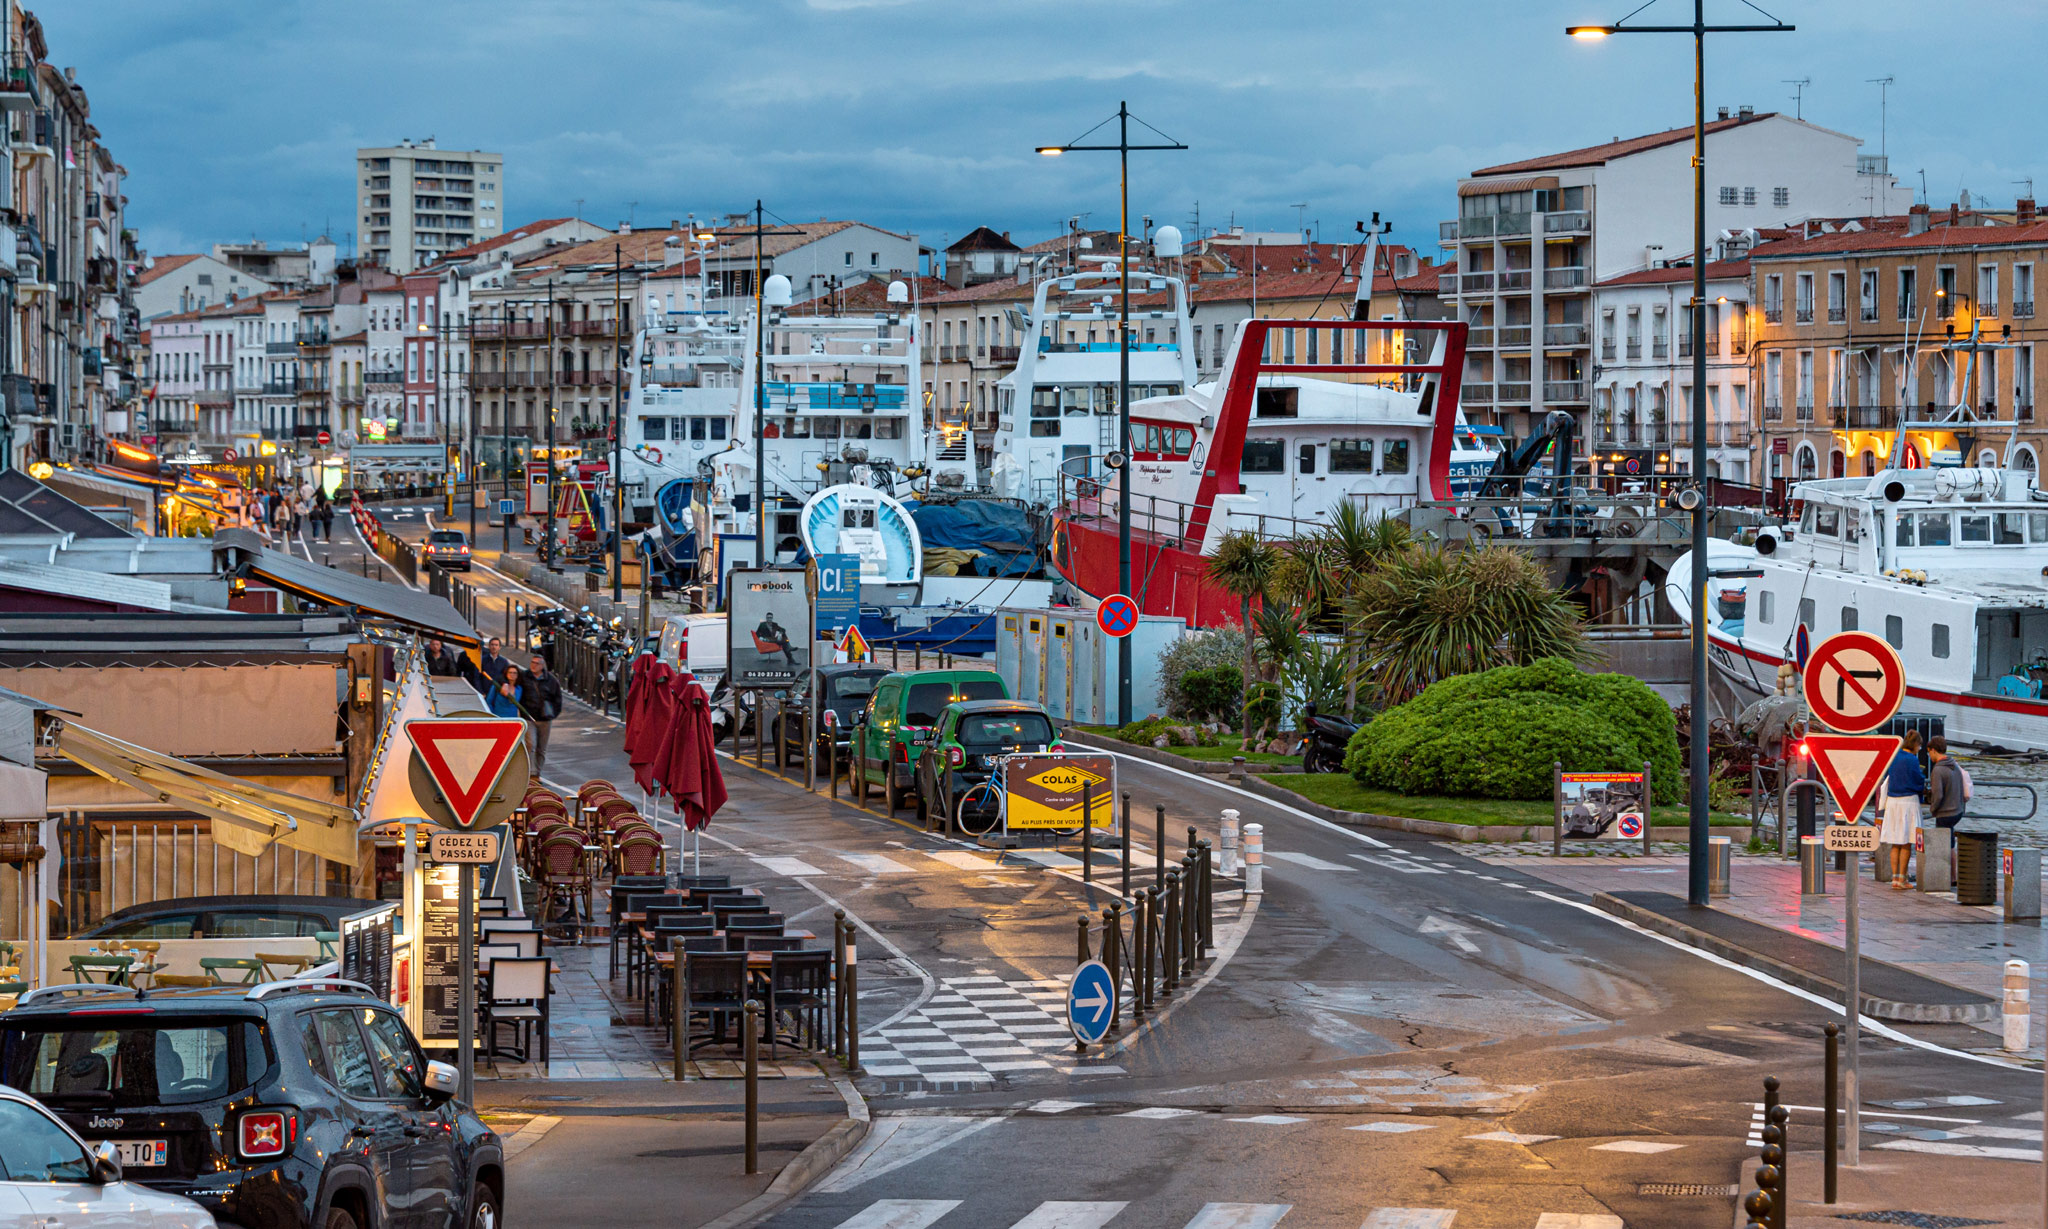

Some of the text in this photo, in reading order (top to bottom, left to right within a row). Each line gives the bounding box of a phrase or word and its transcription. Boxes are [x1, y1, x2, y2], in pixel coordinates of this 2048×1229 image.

[1042, 776, 1077, 784] COLAS
[1831, 829, 1872, 838] CÉDEZ LE
[440, 836, 488, 847] CÉDEZ LE
[1831, 840, 1871, 848] PASSAGE
[441, 849, 487, 859] PASSAGE
[88, 1115, 124, 1130] Jeep
[155, 1153, 165, 1163] 34
